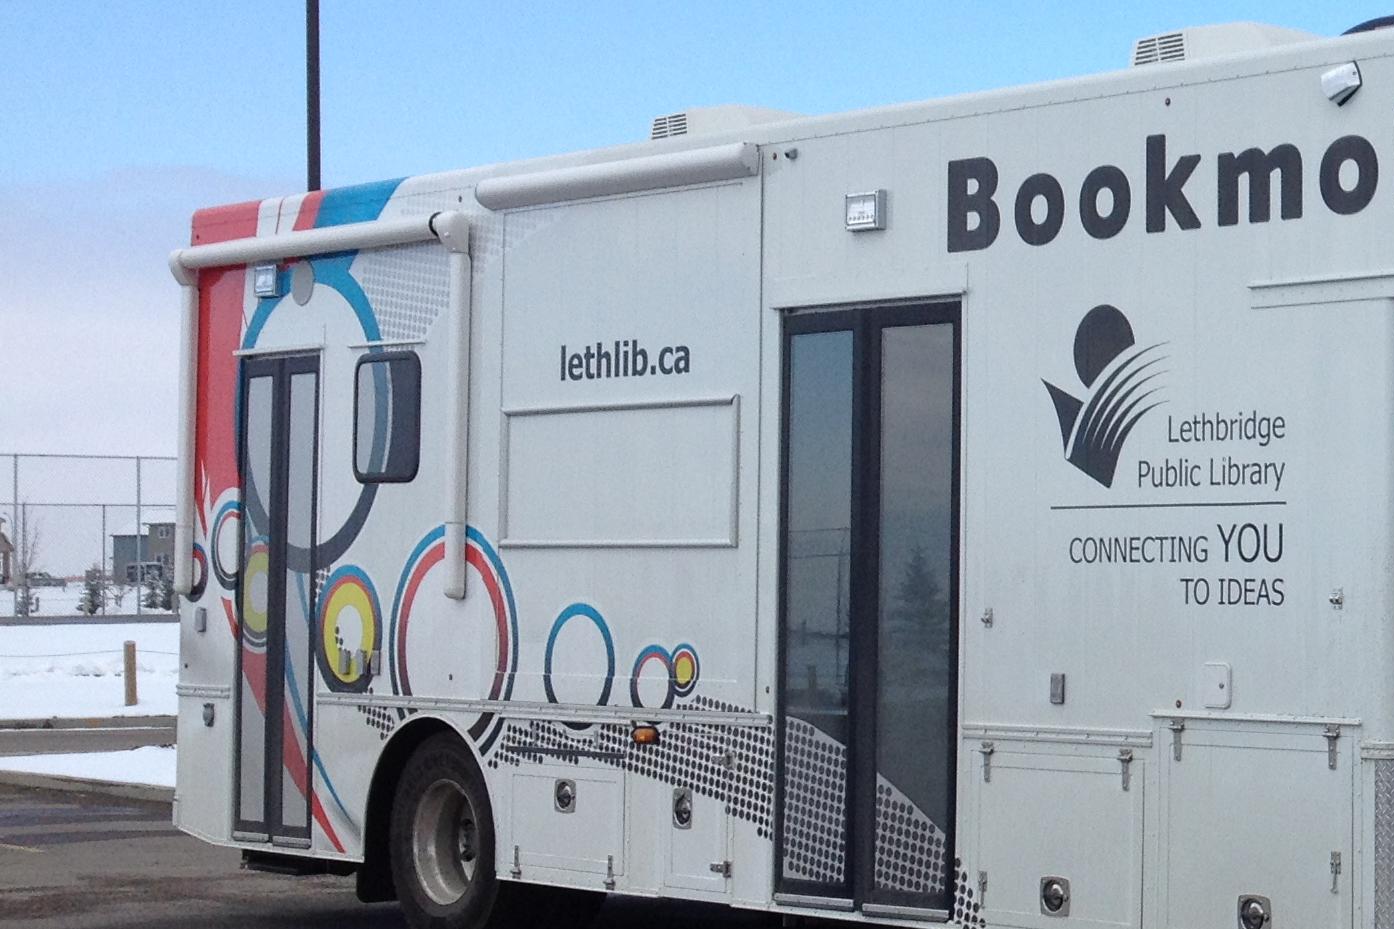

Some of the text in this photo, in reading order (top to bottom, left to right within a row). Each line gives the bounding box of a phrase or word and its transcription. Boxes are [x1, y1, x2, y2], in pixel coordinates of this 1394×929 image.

[560, 339, 690, 381] lethlib.ca
[1168, 410, 1286, 446] Lethbridge
[1138, 456, 1286, 491] Public Library
[1069, 523, 1284, 564] CONNECTING YOU
[1180, 578, 1285, 606] TO IDEAS
